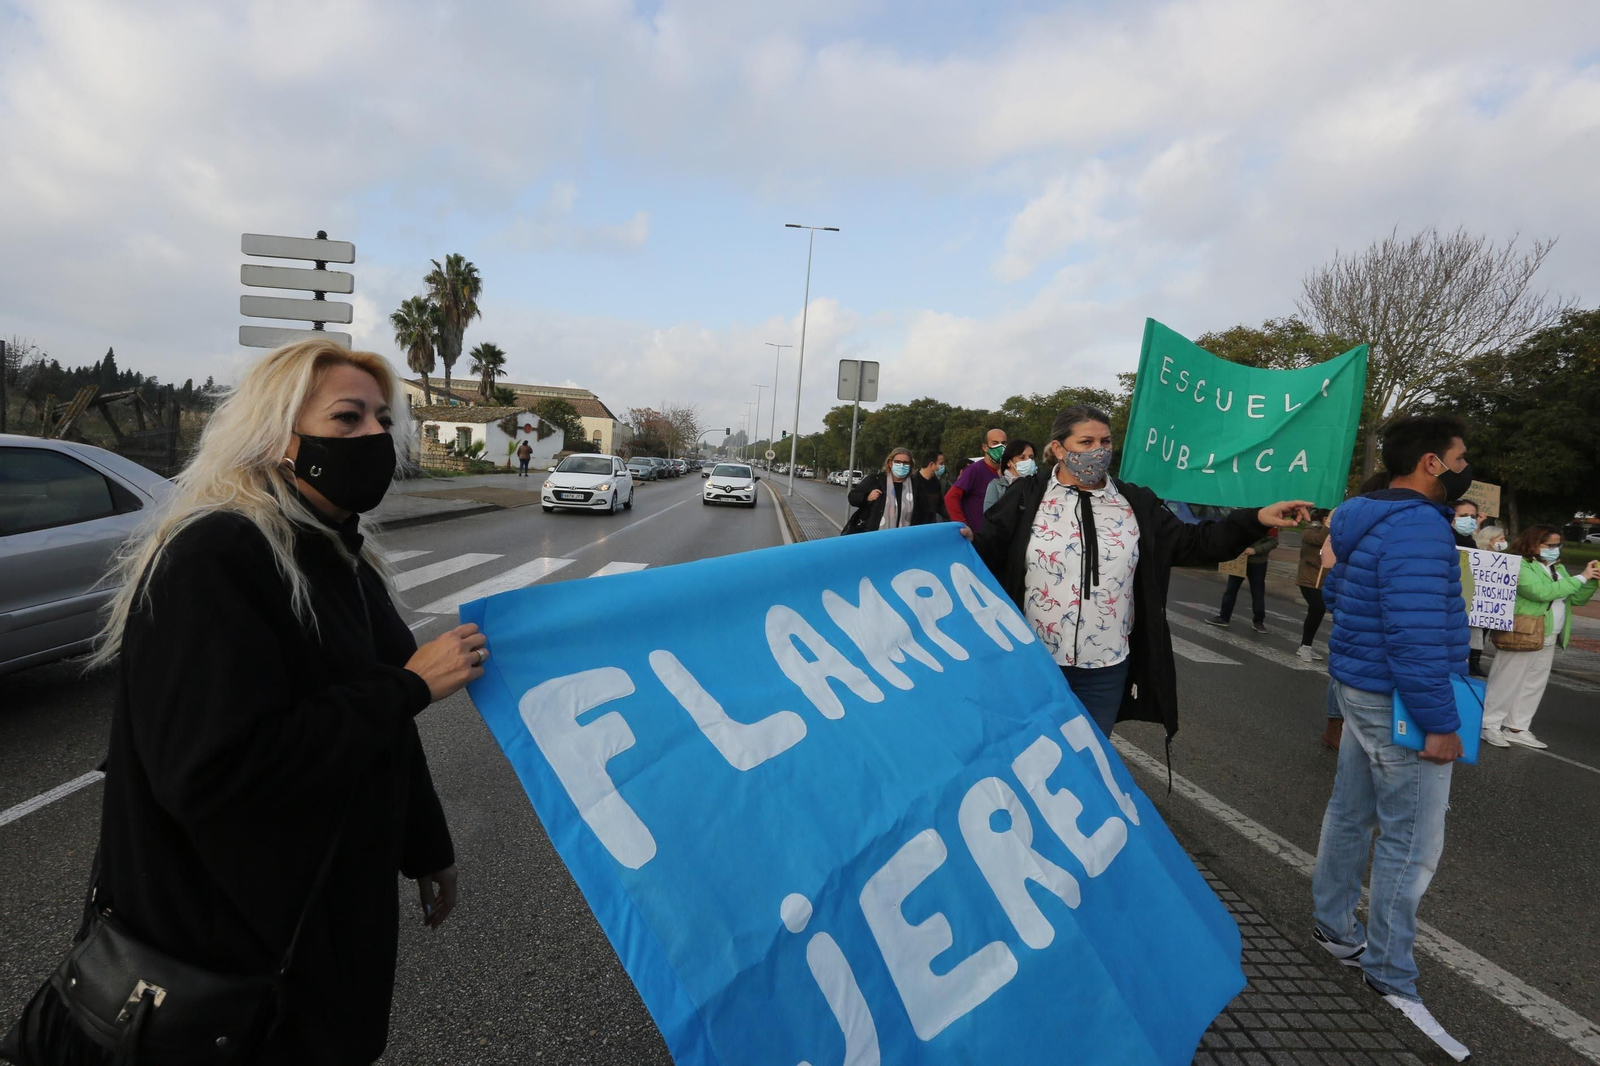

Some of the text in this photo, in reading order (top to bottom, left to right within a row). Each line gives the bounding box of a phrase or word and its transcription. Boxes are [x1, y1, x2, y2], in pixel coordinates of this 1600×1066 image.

[1145, 424, 1309, 474] PÚBLICA
[1469, 552, 1508, 570] S YA
[1472, 568, 1517, 587] ERECHOS
[1476, 600, 1506, 616] HIJOS
[1479, 615, 1513, 631] ESPERAR
[518, 561, 1036, 870] FLAMPA
